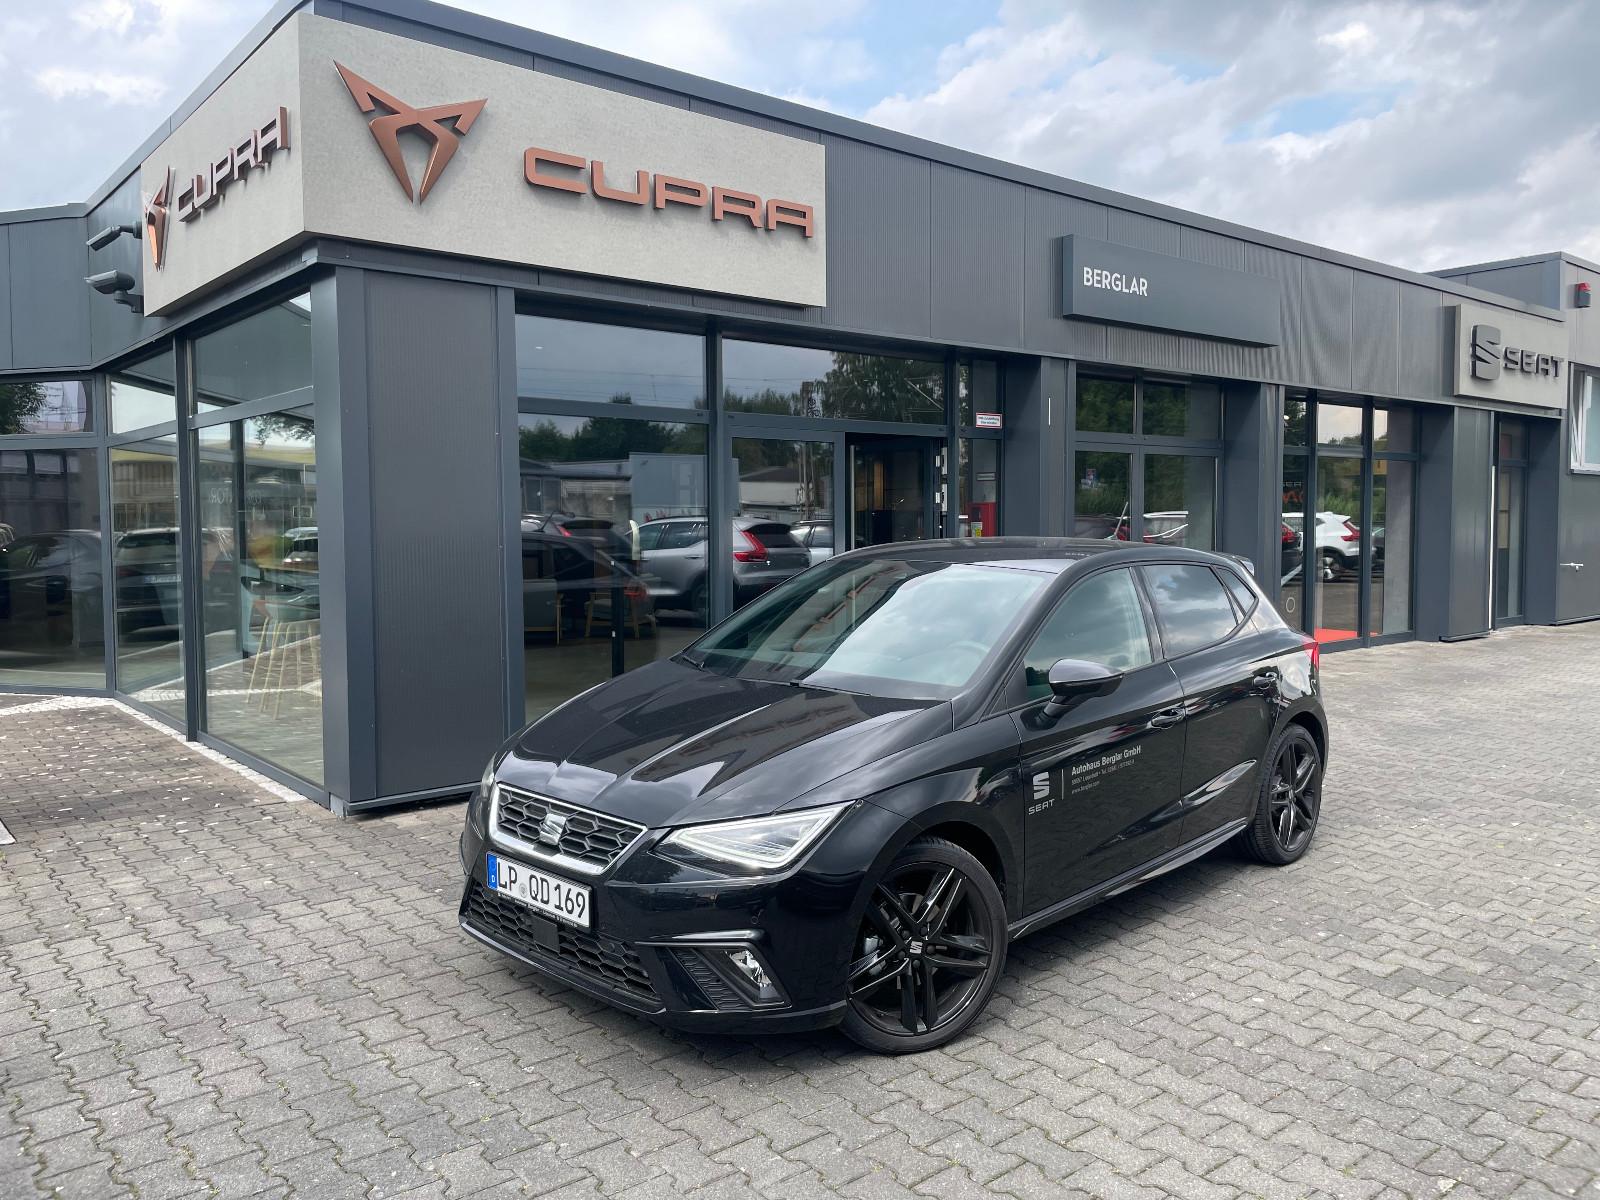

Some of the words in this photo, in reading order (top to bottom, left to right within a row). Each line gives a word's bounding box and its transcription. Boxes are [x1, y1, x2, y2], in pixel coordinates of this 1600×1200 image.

[178, 106, 288, 222] CUPRA
[524, 147, 813, 238] CUPRA
[1083, 266, 1148, 297] BERGLAR
[1504, 346, 1565, 378] SEAT
[1071, 760, 1101, 776] Autohaus
[1101, 753, 1123, 767] Berglar
[1123, 745, 1141, 759] GmbH
[1028, 798, 1056, 815] SEAT
[497, 861, 518, 892] LP
[529, 874, 550, 905] QD
[554, 883, 586, 918] 169
